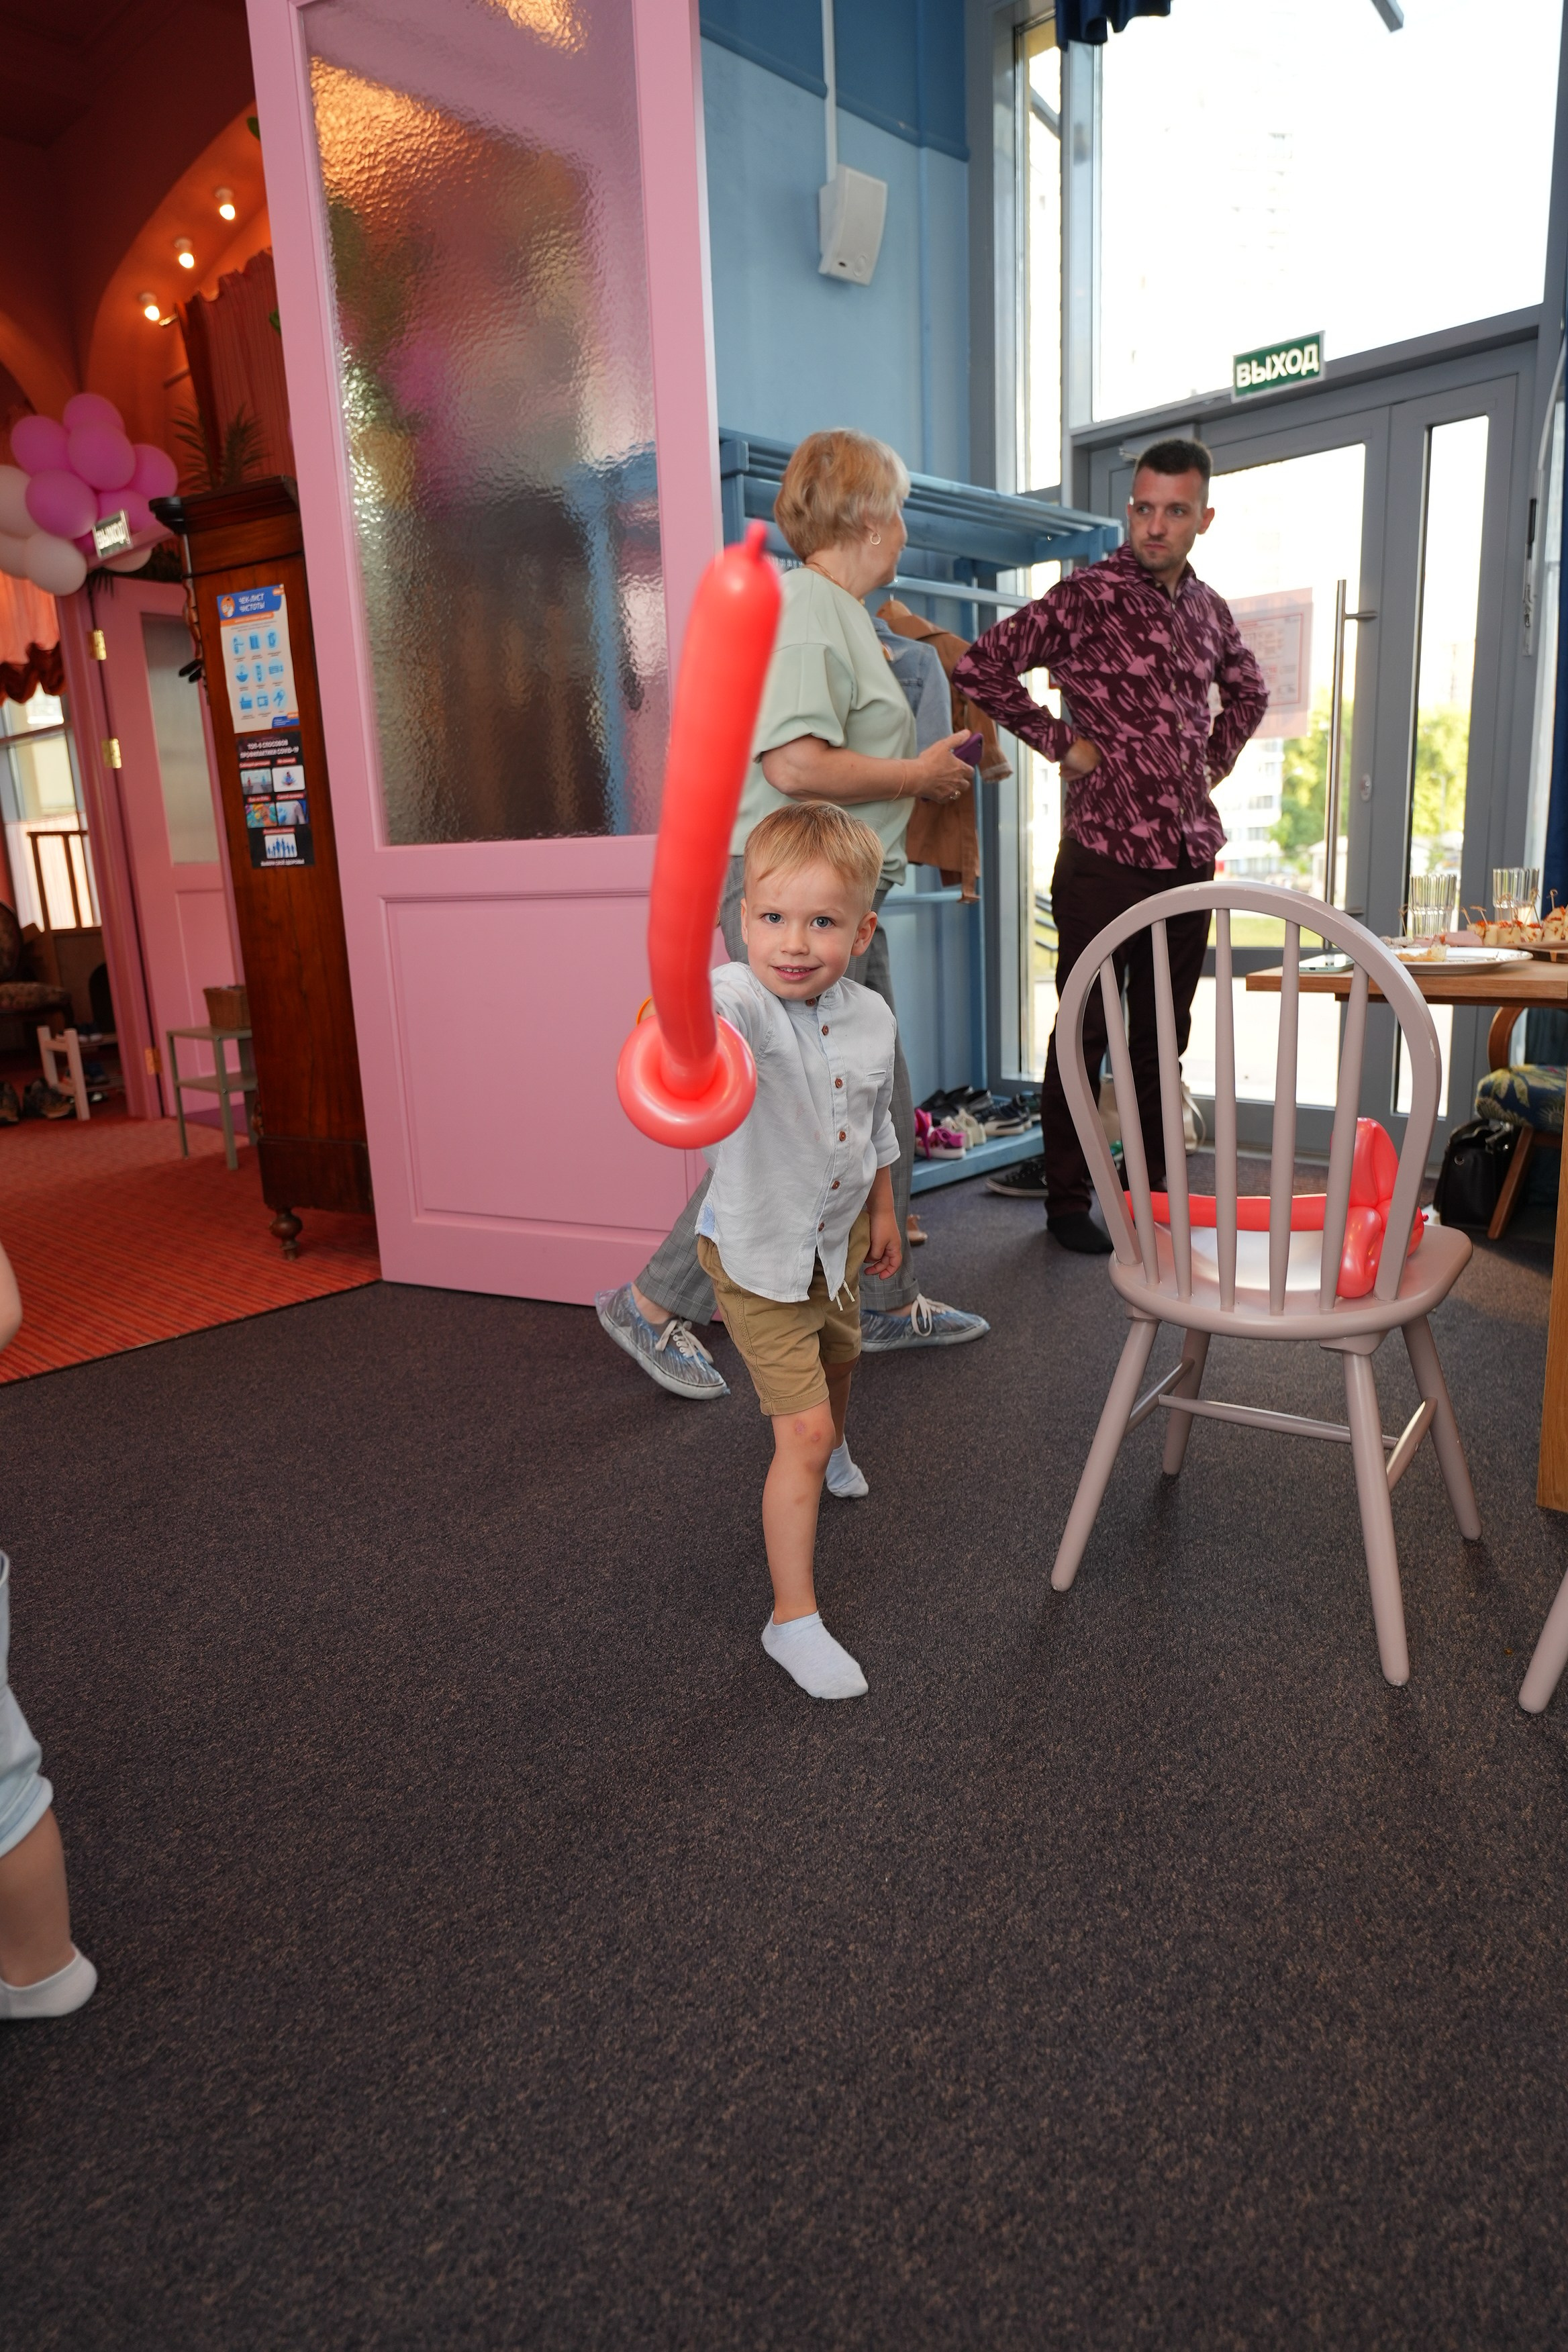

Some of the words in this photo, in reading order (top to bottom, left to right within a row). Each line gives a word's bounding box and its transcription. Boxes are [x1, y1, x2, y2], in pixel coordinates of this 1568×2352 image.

[1236, 342, 1319, 388] ВЫХОД
[96, 520, 126, 550] ВЫХОД
[238, 593, 264, 604] ЧЕК-ЛИСТ
[239, 601, 265, 613] ЧИСТОТЫ
